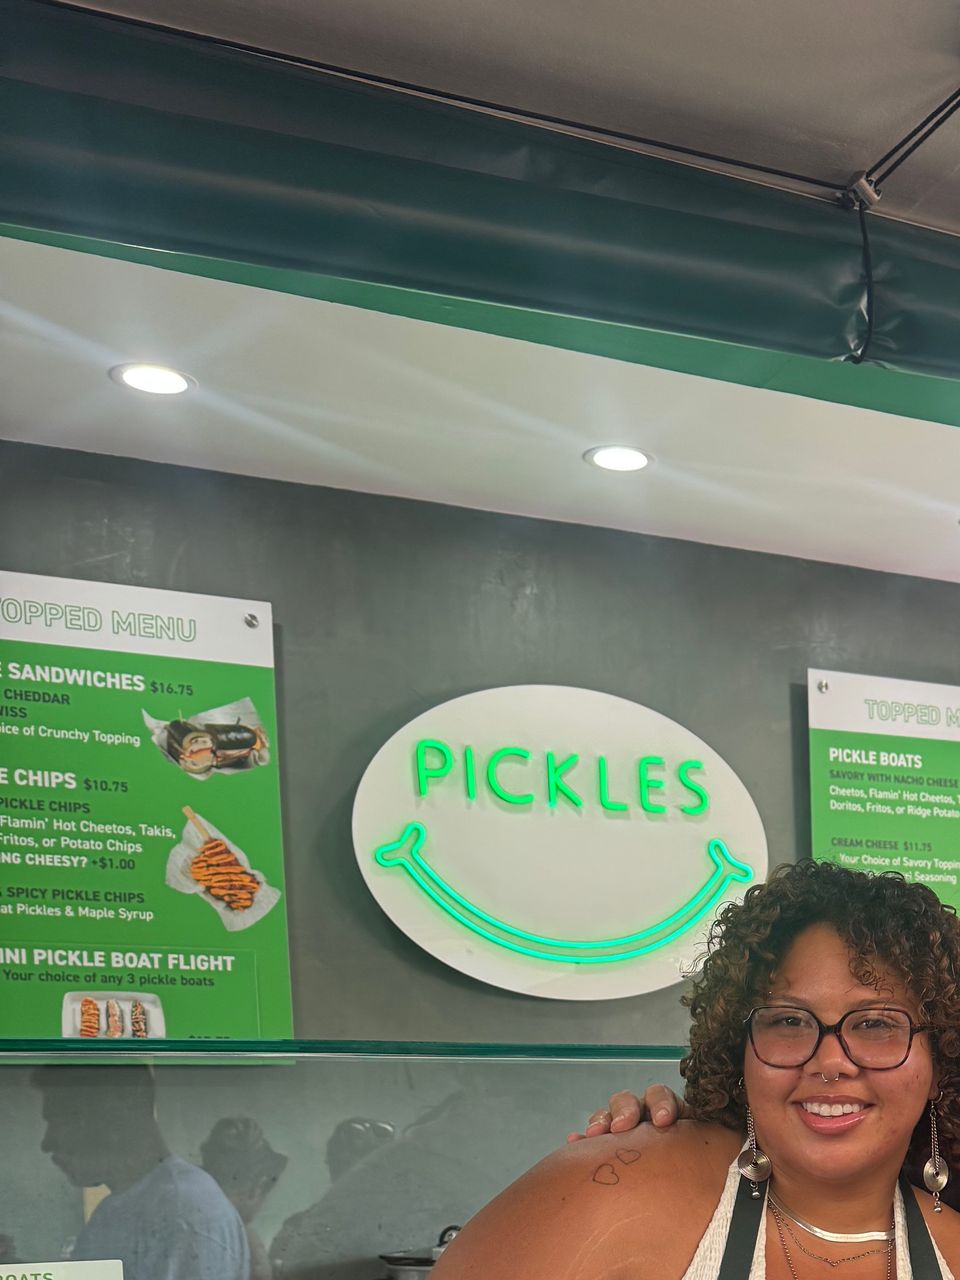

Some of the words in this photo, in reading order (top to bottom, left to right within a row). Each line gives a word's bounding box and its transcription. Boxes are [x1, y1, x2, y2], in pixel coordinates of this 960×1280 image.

[0, 598, 102, 631] OPPED
[112, 610, 196, 642] MENU
[8, 662, 145, 691] SANDWICHES
[150, 681, 193, 696] $16.75
[4, 688, 70, 704] CHEDDAR
[864, 699, 941, 726] TOPPED
[0, 722, 19, 735] ice
[23, 725, 35, 736] of
[38, 725, 89, 743] Crunchy
[93, 730, 141, 748] Topping
[829, 748, 877, 765] PICKLE
[880, 752, 922, 769] BOATS
[14, 768, 77, 789] CHIPS
[83, 778, 128, 793] $10.75
[415, 739, 709, 815] PICKLES
[829, 769, 865, 781] SAVORY
[867, 773, 891, 783] WITH
[893, 775, 925, 786] NACHO
[926, 776, 958, 789] CHEESE
[829, 785, 867, 799] Cheetos,
[869, 788, 901, 800] Flamin'
[903, 790, 918, 801] Hot
[919, 791, 956, 805] Cheetos,
[49, 800, 90, 813] CHIPS
[830, 799, 865, 812] Doritos,
[866, 802, 894, 814] Fritos,
[895, 806, 905, 814] or
[907, 805, 931, 818] Ridge
[933, 807, 960, 818] Potato
[0, 815, 48, 829] Flamin'
[53, 818, 76, 832] Hot
[81, 821, 136, 837] Cheetos,
[139, 824, 176, 839] Takis,
[42, 838, 56, 847] or
[61, 836, 103, 850] Potato
[106, 839, 143, 853] Chips
[831, 837, 863, 848] CREAM
[865, 839, 899, 850] CHEESE
[903, 841, 932, 851] $11.75
[25, 853, 88, 868] CHEESY?
[840, 853, 859, 864] Your
[861, 854, 890, 866] Choice
[892, 857, 900, 866] of
[902, 856, 932, 869] Savory
[915, 872, 957, 884] Seasoning
[7, 886, 48, 899] SPICY
[52, 889, 101, 901] PICKLE
[104, 891, 144, 903] CHIPS
[16, 903, 62, 916] Pickles
[65, 905, 74, 917] &
[78, 906, 115, 920] Maple
[119, 908, 154, 921] Syrup
[33, 949, 105, 967] PICKLE
[111, 952, 162, 969] BOAT
[168, 954, 235, 971] FLIGHT
[3, 969, 34, 981] Your
[38, 970, 80, 983] choice
[85, 971, 97, 983] of
[100, 974, 123, 986] any
[127, 973, 135, 984] 3
[139, 974, 177, 988] pickle
[180, 975, 215, 987] boats
